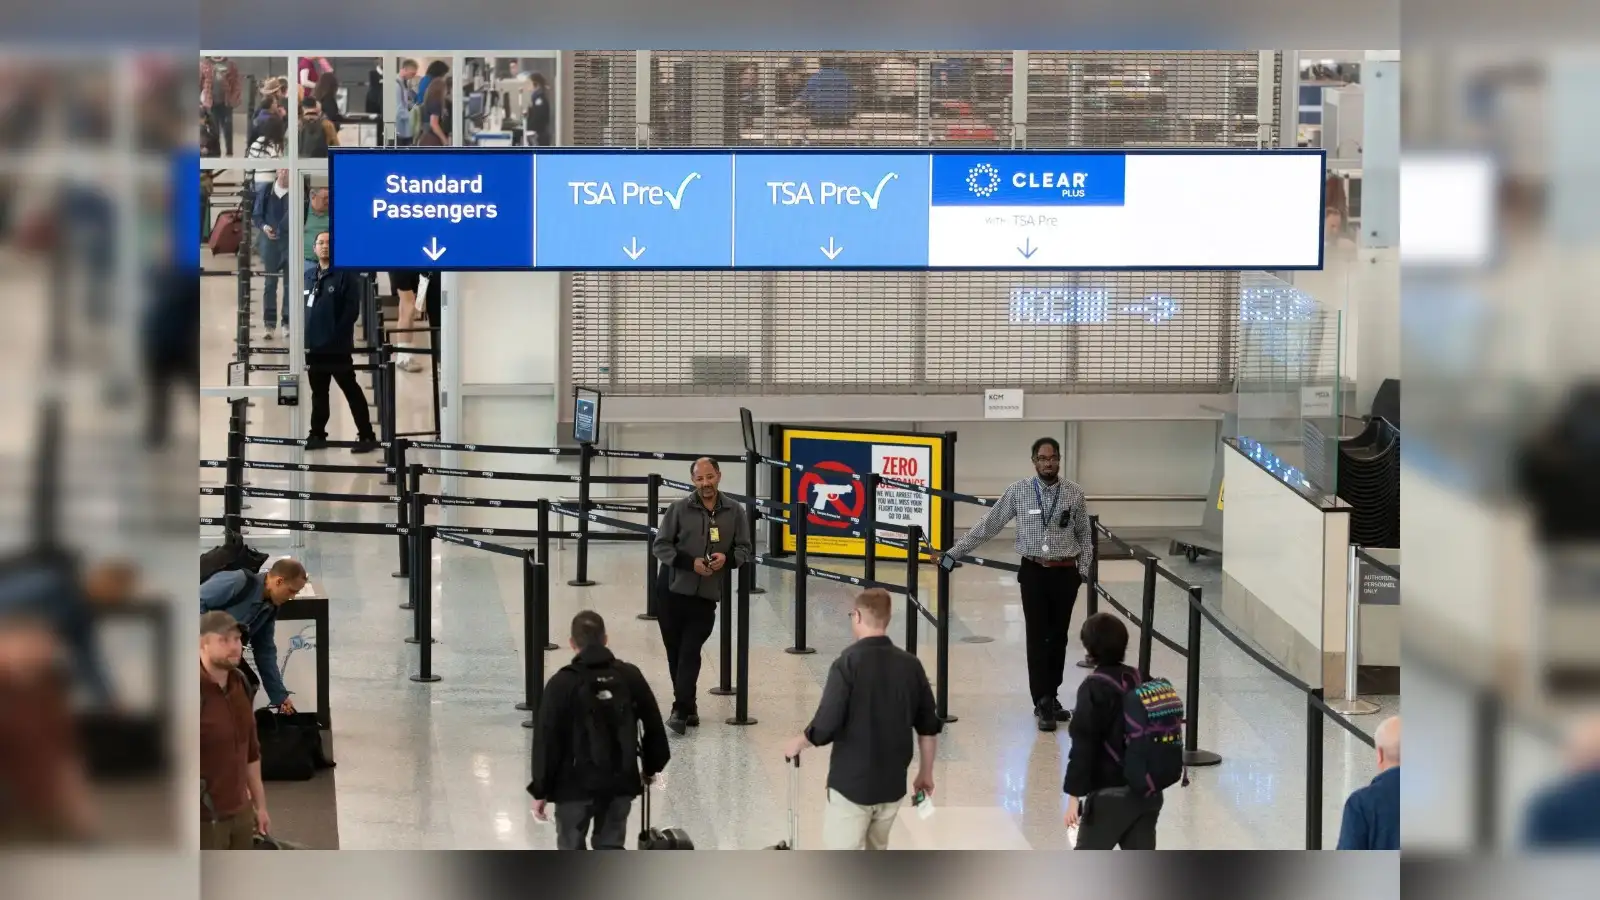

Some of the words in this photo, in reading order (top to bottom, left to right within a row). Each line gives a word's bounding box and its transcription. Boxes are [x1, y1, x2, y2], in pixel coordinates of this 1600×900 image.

[386, 174, 483, 194] Standard
[1012, 172, 1086, 188] CLEAR
[568, 181, 616, 206] TSA
[622, 181, 664, 206] Pre
[767, 181, 815, 206] TSA
[820, 181, 861, 206] Pre
[1062, 189, 1086, 198] PLUS
[372, 199, 498, 224] Passengers
[1012, 214, 1036, 227] TSA
[1038, 214, 1058, 227] Pre
[882, 456, 918, 476] ZERO
[885, 490, 895, 498] WILL
